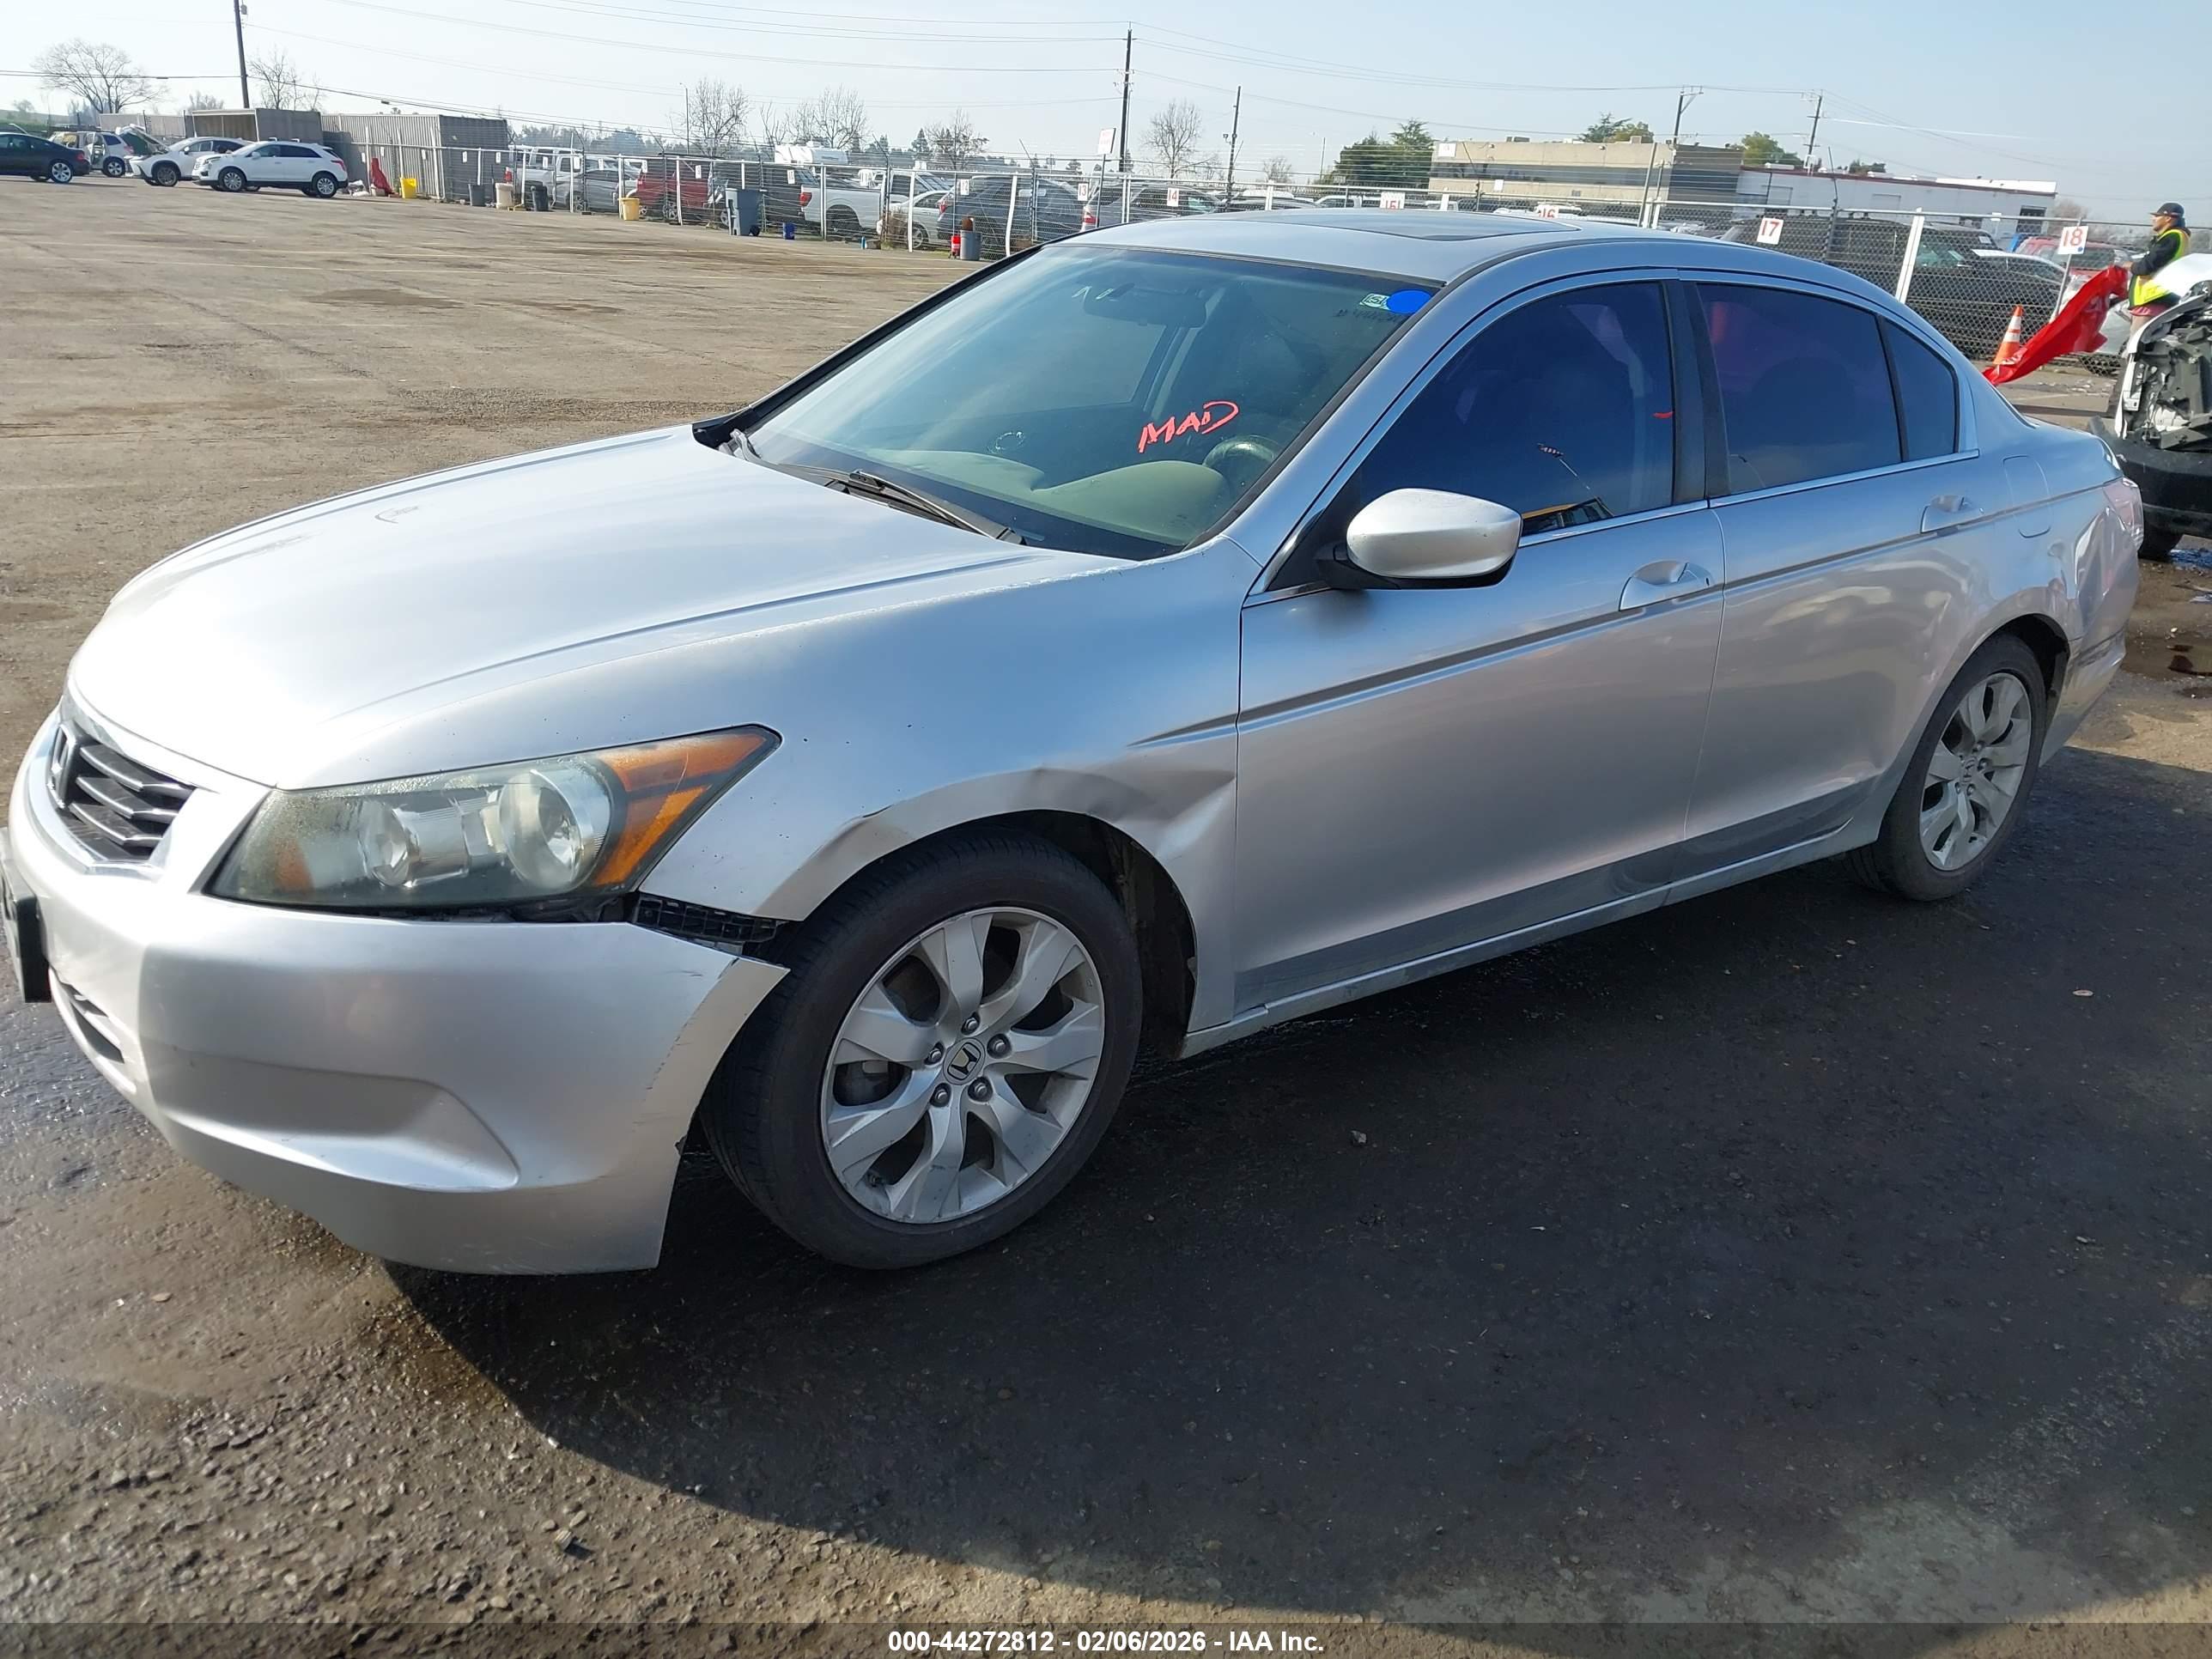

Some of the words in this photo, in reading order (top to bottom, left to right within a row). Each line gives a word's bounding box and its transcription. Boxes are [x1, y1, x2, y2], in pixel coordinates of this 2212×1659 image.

[1079, 185, 1087, 197] 13
[1168, 189, 1177, 201] 14
[1761, 220, 1780, 237] 17
[2063, 228, 2083, 247] 18
[1138, 400, 1239, 453] MAD
